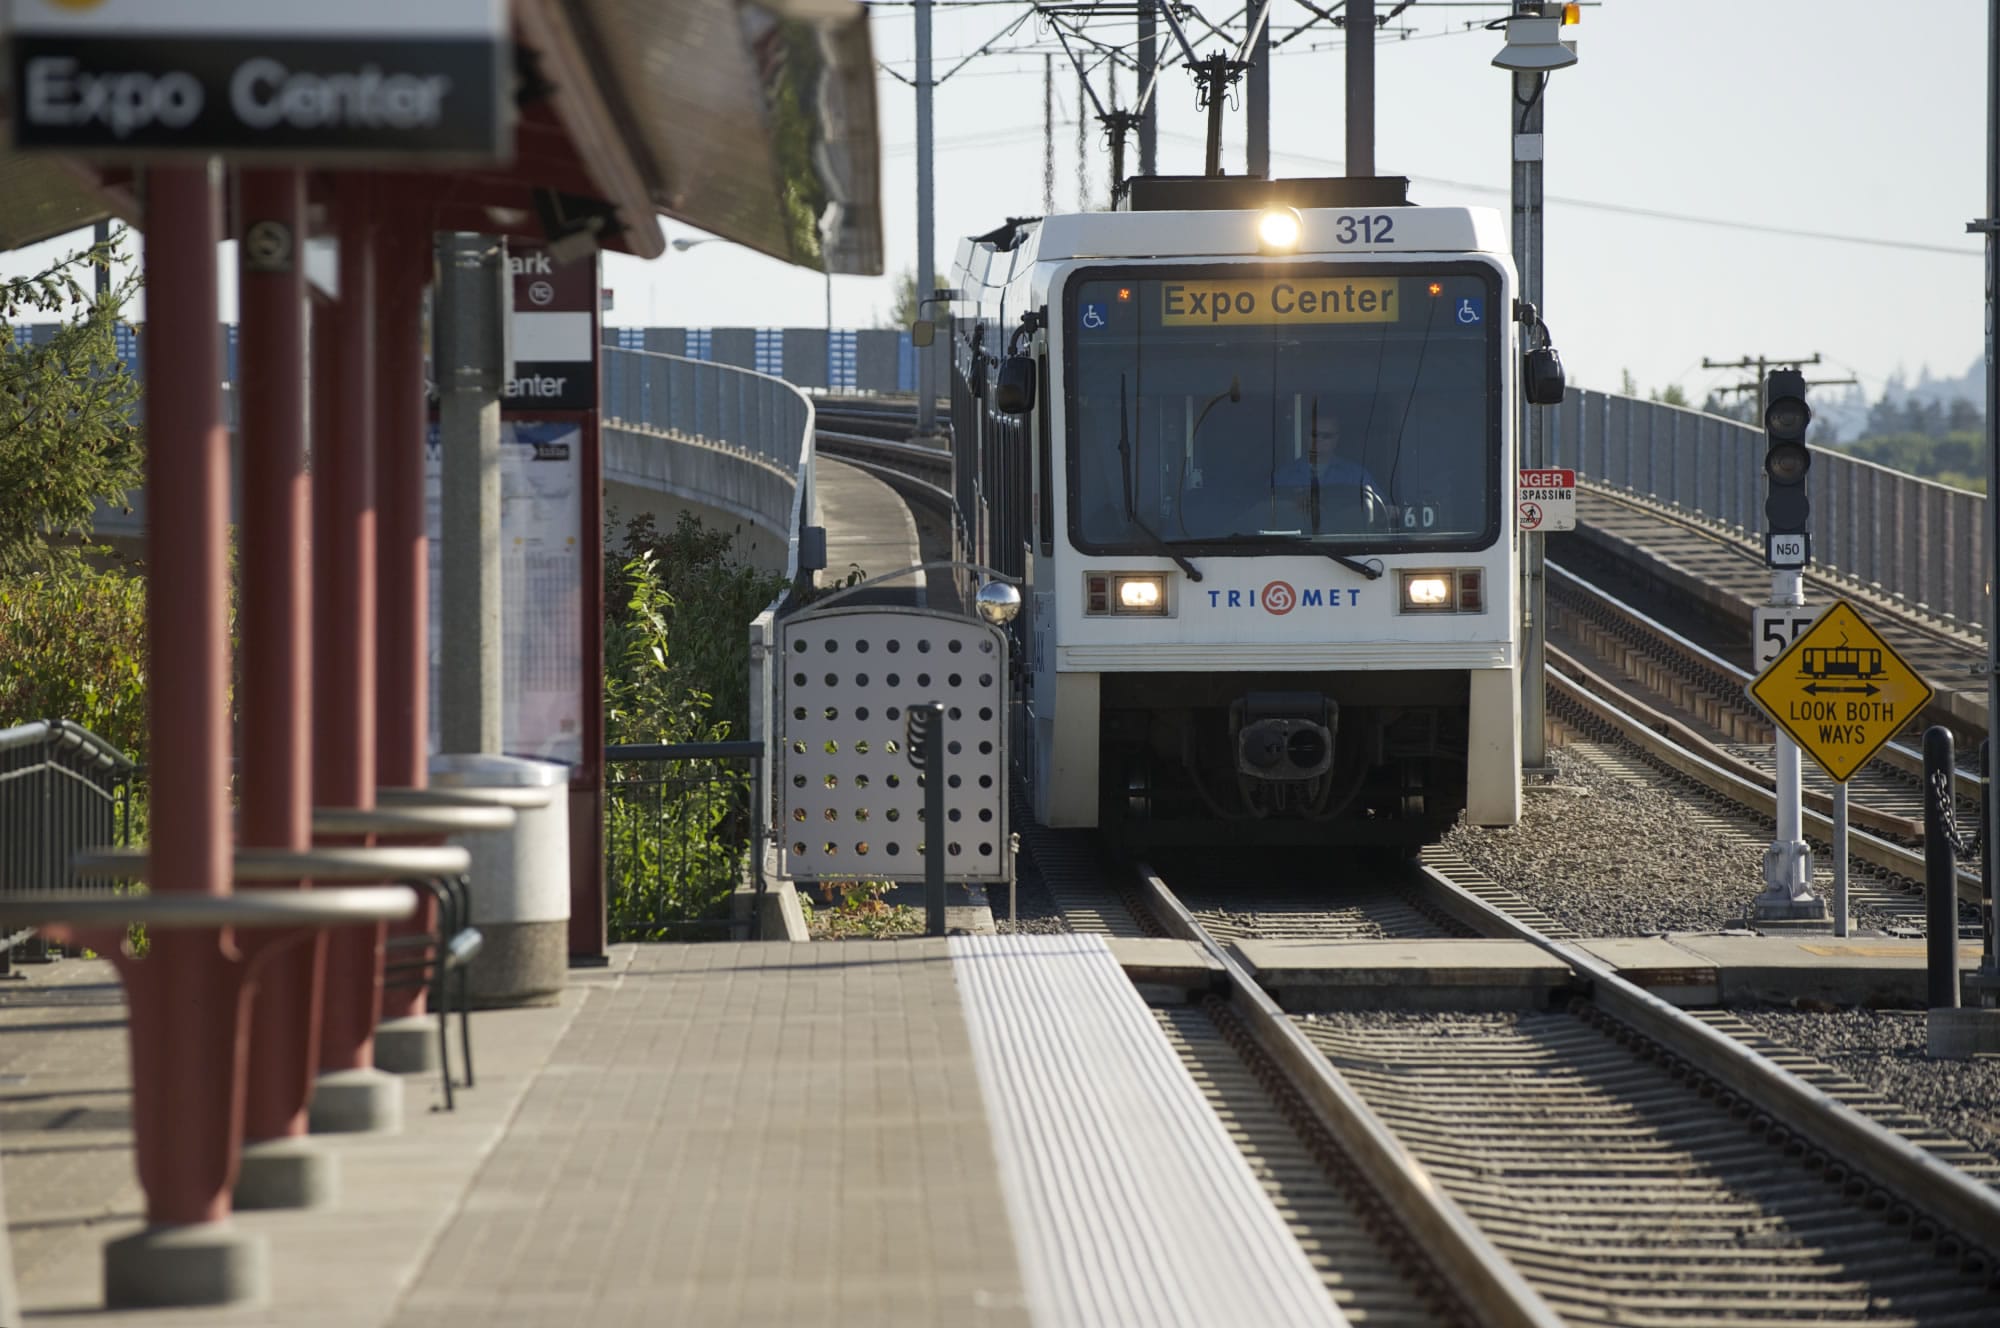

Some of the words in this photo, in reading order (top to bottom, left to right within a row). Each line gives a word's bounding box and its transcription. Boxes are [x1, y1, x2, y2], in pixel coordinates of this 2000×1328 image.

[24, 55, 205, 138] Expo
[229, 56, 451, 131] Center
[1336, 215, 1395, 243] 312
[1164, 284, 1256, 322] Expo
[1270, 283, 1394, 314] Center
[1520, 489, 1571, 500] SPASSING
[1776, 543, 1800, 555] N50
[1208, 590, 1255, 607] TRI
[1302, 589, 1360, 607] MET
[1790, 701, 1837, 721] LOOK
[1846, 702, 1894, 722] BOTH
[1819, 724, 1865, 744] WAYS
